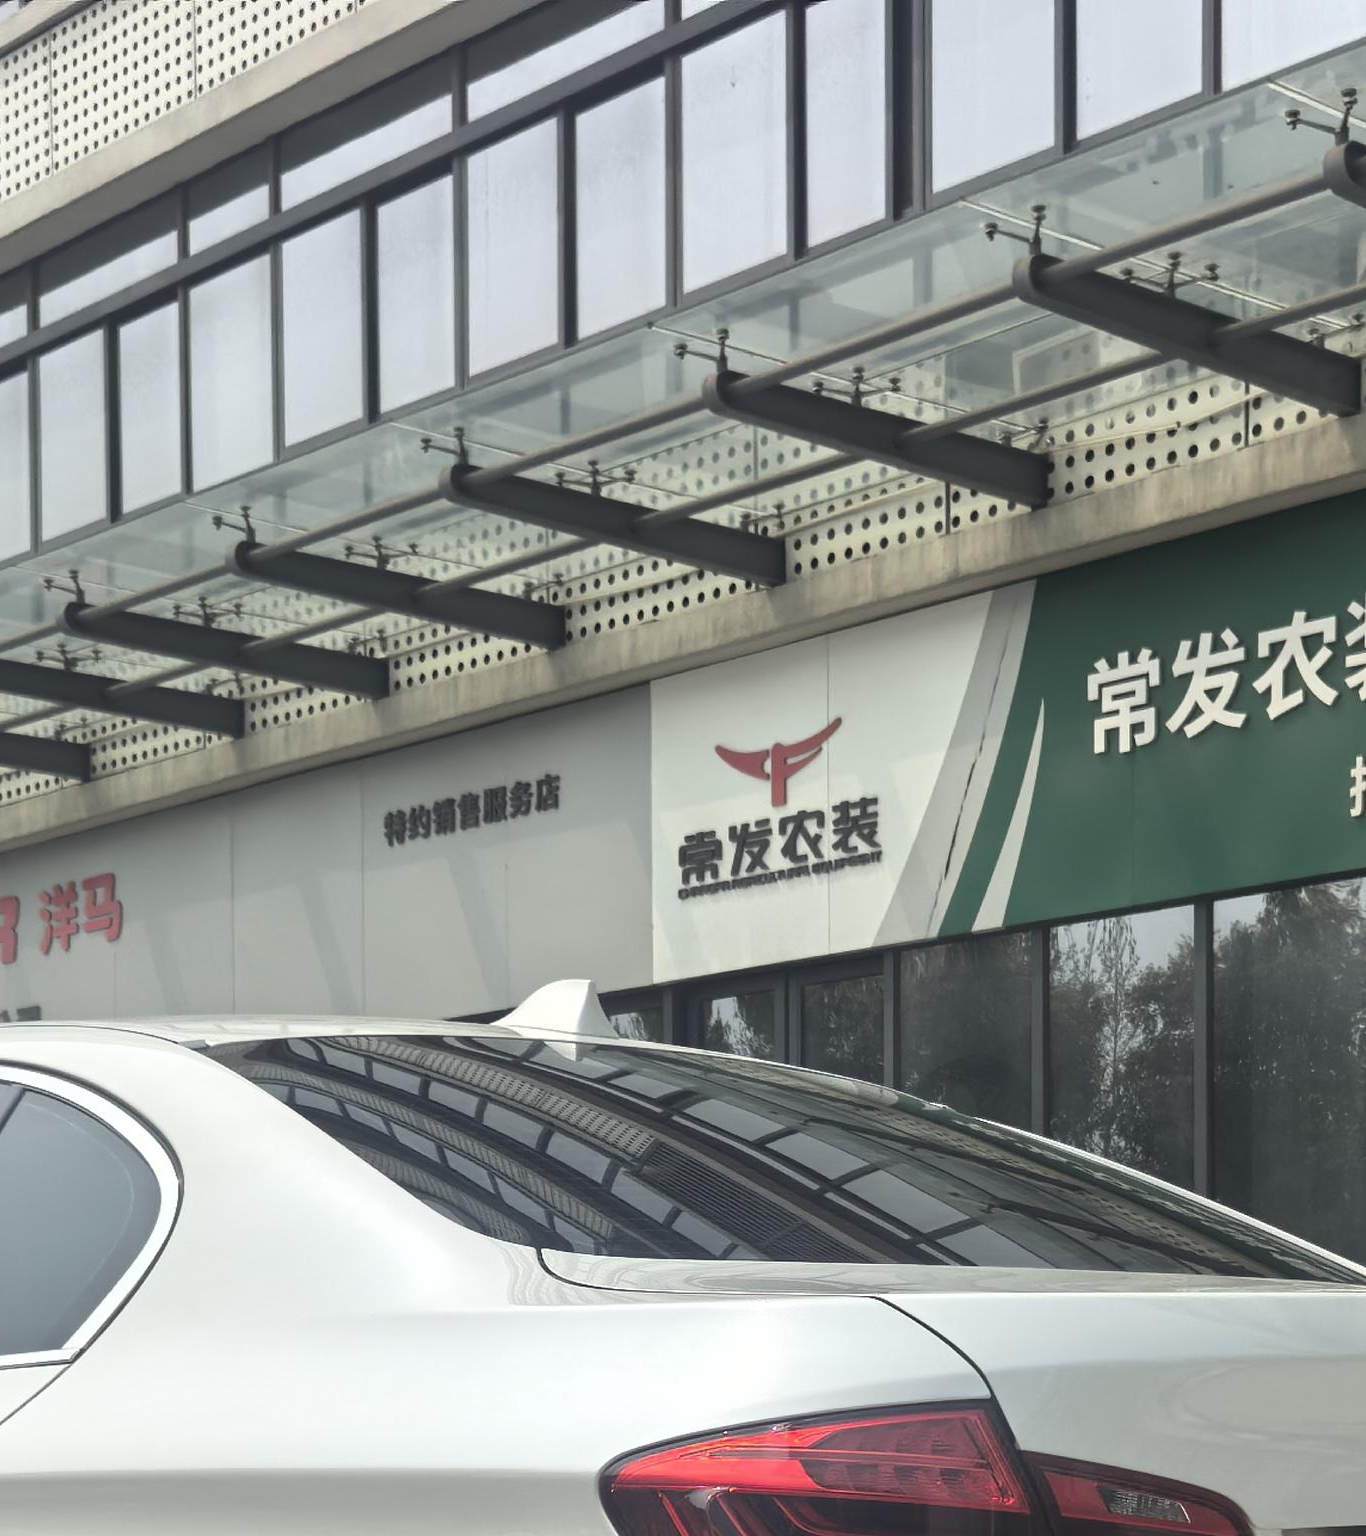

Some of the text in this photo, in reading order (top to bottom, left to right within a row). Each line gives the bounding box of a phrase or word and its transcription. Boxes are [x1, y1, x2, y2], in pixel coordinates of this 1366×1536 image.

[383, 773, 561, 848] 特约销售服务店
[678, 797, 883, 886] 常发农装
[38, 872, 123, 955] 洋马
